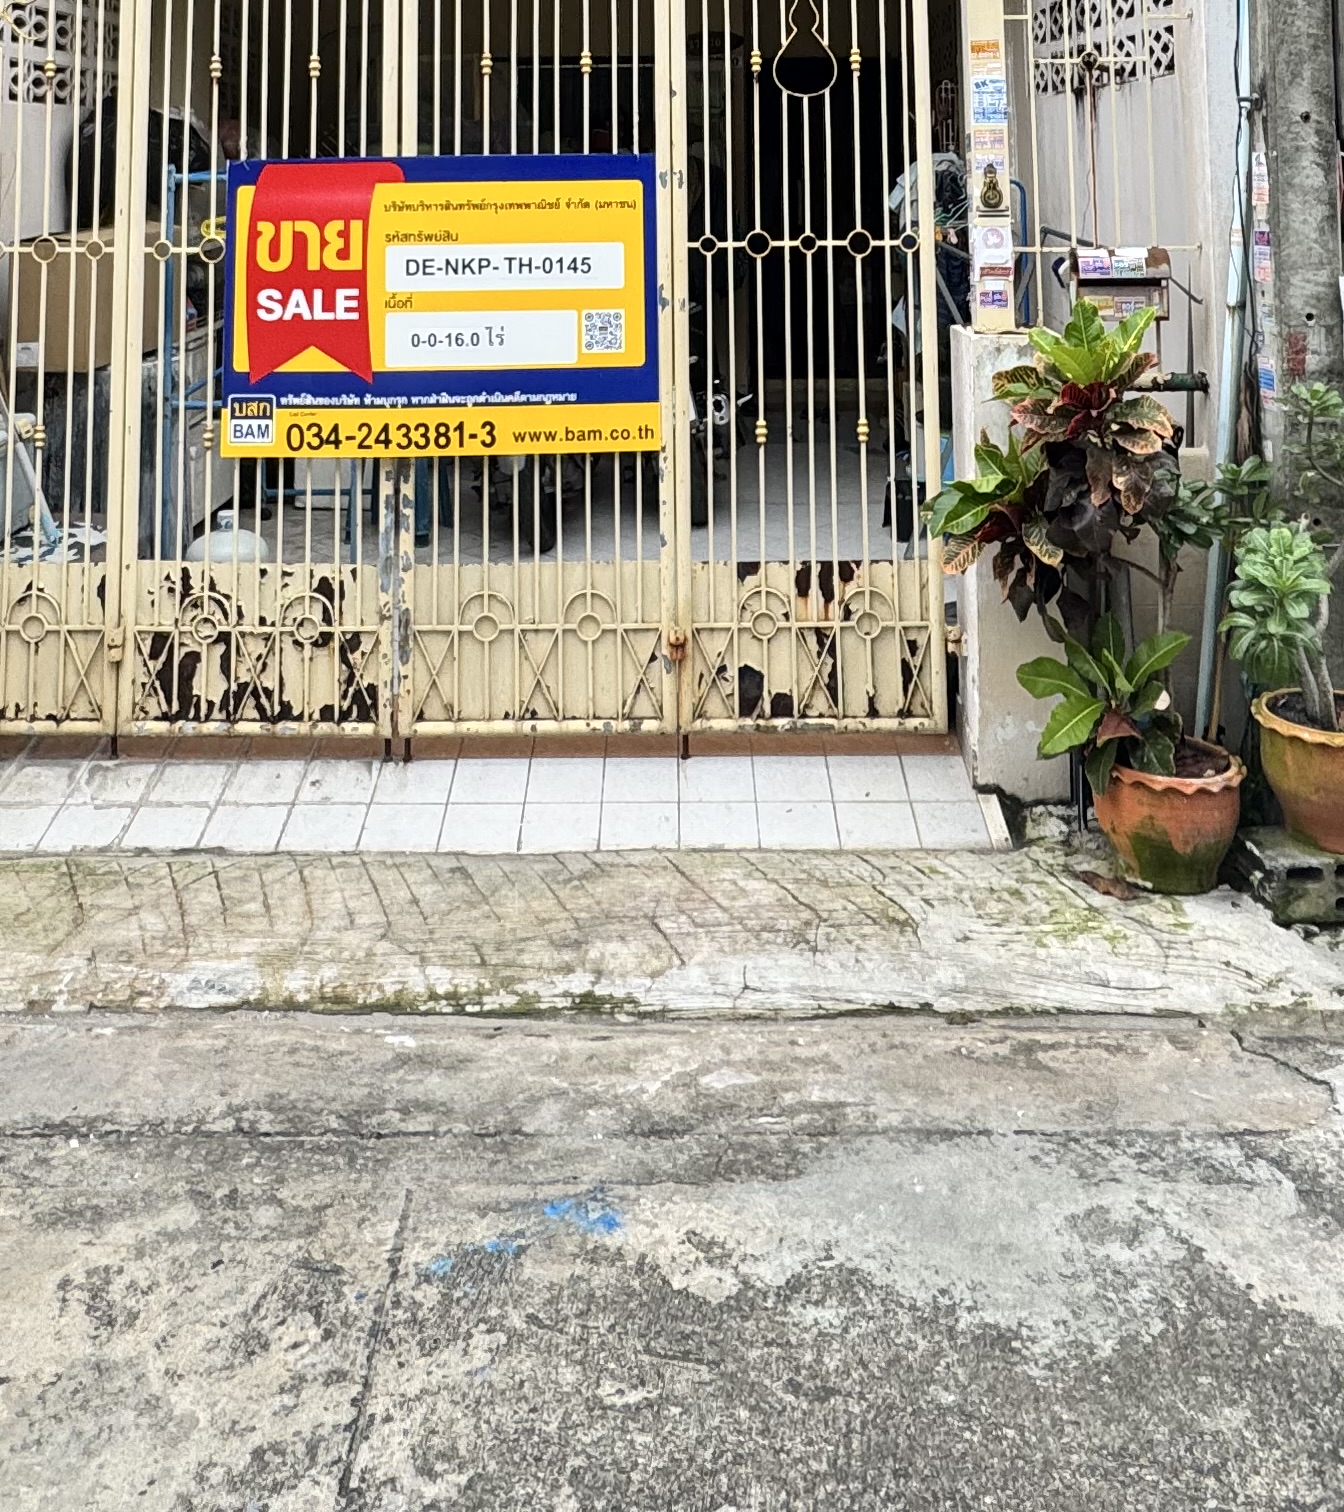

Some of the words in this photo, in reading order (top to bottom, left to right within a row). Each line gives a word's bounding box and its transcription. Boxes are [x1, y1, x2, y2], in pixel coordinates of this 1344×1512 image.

[565, 197, 590, 210] จำกัด
[594, 199, 636, 211] (มหาชน)
[384, 230, 459, 243] รหัสทรัพย์สิน
[256, 219, 363, 272] ขาย
[256, 288, 360, 321] SALE
[384, 293, 413, 309] เนื้อที่
[411, 332, 480, 348] 0-0-16.0
[484, 326, 505, 347] ไร่
[233, 400, 270, 417] บสก
[233, 423, 270, 439] BAM
[286, 420, 497, 451] 034-243381-3
[512, 424, 655, 443] www.bam.co.th
